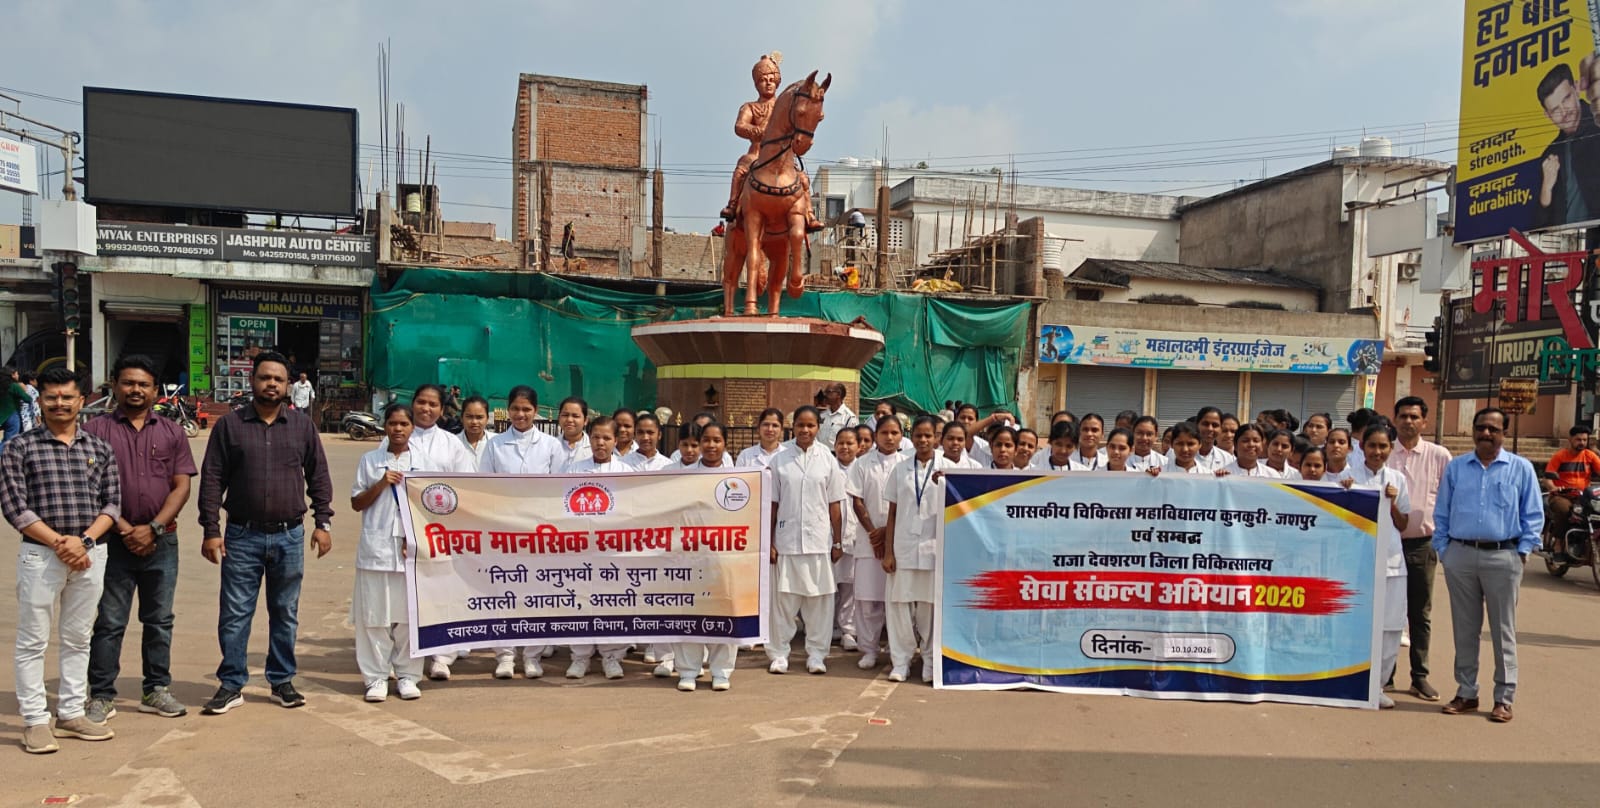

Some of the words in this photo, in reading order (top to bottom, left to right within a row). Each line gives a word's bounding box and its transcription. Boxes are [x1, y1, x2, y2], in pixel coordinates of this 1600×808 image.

[1477, 1, 1513, 47] हर
[1474, 19, 1573, 88] दमदार
[1470, 128, 1518, 154] दमदार
[1470, 142, 1526, 171] strength.
[1469, 173, 1518, 198] दमदार
[1469, 187, 1533, 216] durability.
[137, 231, 218, 245] ENTERPRISES
[226, 234, 286, 249] JASHPUR
[289, 238, 322, 251] AUTO
[325, 240, 371, 253] CENTRE
[222, 289, 278, 302] JASHPUR
[281, 292, 312, 304] AUTO
[315, 294, 359, 306] CENTRE
[258, 303, 292, 314] MINU
[294, 304, 324, 315] JAIN
[239, 319, 267, 329] OPEN
[1006, 502, 1070, 519] शासकीय
[1074, 503, 1132, 520] चिकित्सा
[1136, 504, 1217, 522] महाविद्यालय
[1276, 512, 1317, 530] जशपुर
[425, 523, 482, 558] विश्व
[488, 524, 590, 554] मानसिक
[595, 527, 674, 552] स्वास्थ्य
[680, 525, 750, 552] सप्ताह
[1131, 527, 1155, 542] एवं
[1052, 554, 1086, 568] राजा
[1088, 551, 1146, 568] देवशरण
[1149, 551, 1190, 569] जिला
[1192, 553, 1274, 571] चिकित्सालय
[535, 562, 592, 588] अनुभवों
[599, 562, 619, 581] को
[626, 566, 658, 587] सुना
[664, 567, 692, 581] गया
[467, 591, 516, 611] असली
[589, 588, 637, 608] असली
[643, 592, 695, 607] बदलाव
[1019, 575, 1069, 601] सेवा
[1073, 575, 1154, 603] संकल्प
[1158, 577, 1252, 606] अभियान
[1255, 584, 1306, 608] 2026
[447, 623, 488, 639] स्वास्थ्य
[492, 620, 507, 636] एवं
[511, 619, 546, 634] परिवार
[550, 621, 588, 633] कल्याण
[1171, 646, 1212, 654] 10.10.2026
